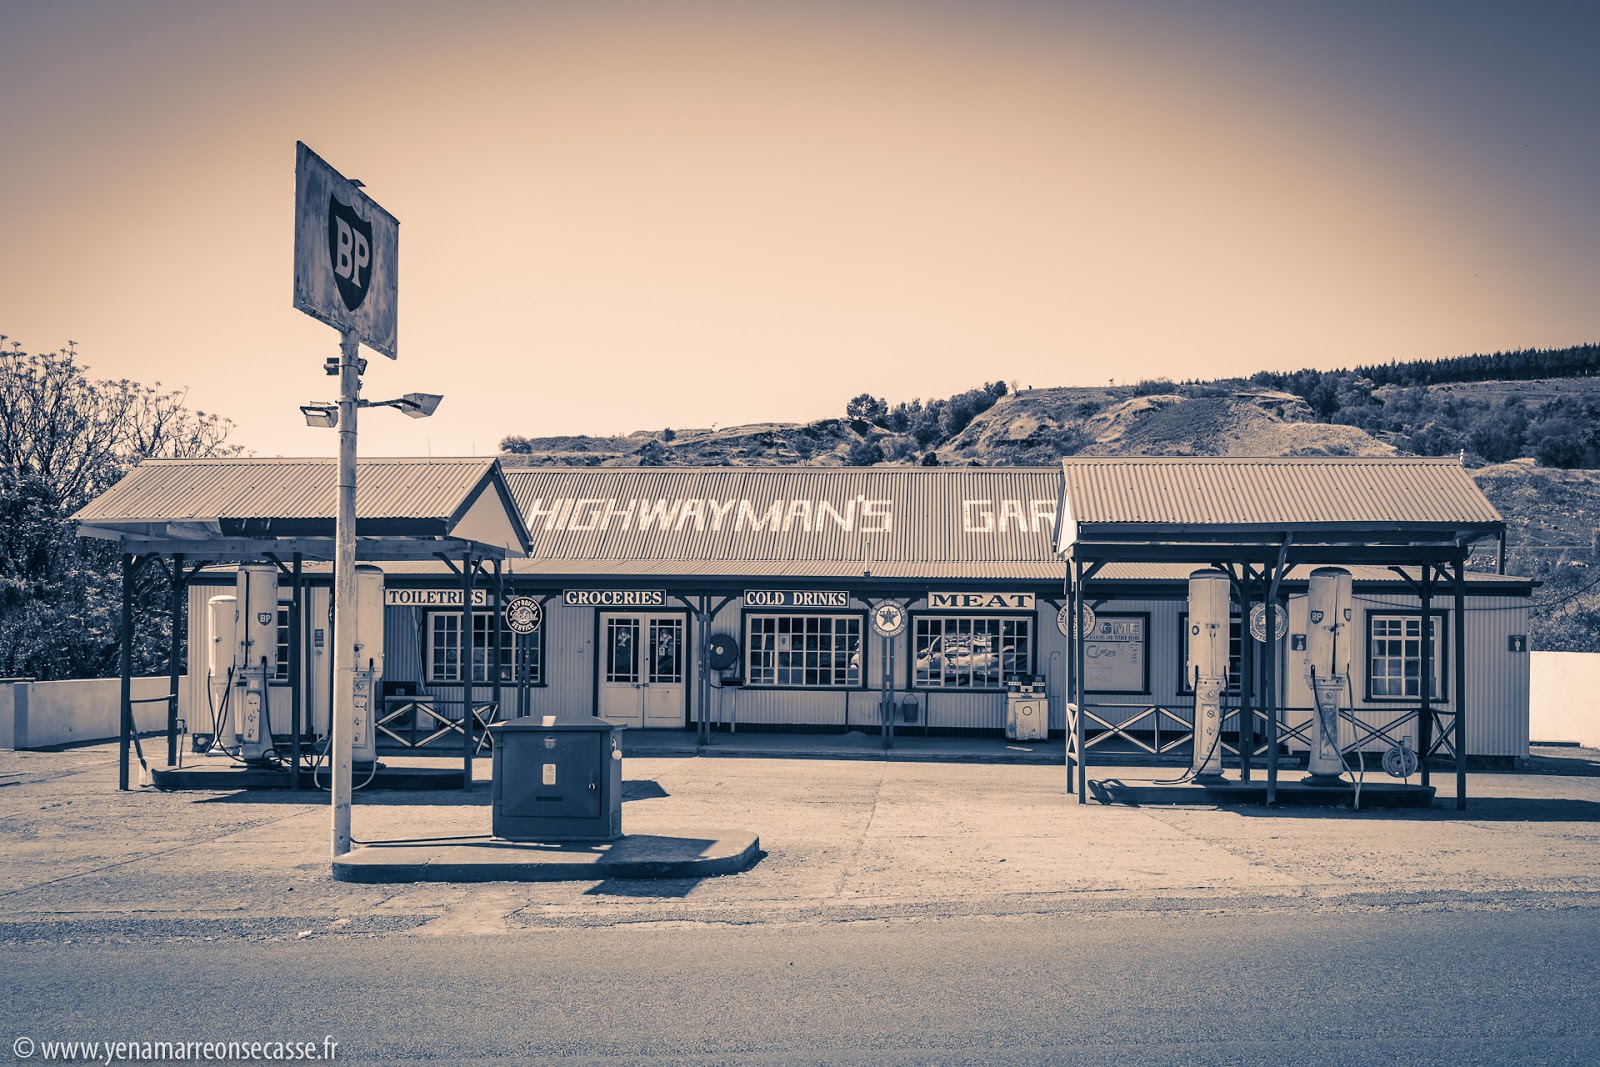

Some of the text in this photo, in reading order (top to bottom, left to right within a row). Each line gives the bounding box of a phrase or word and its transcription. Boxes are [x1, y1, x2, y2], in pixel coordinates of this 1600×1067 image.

[334, 215, 369, 288] BP
[526, 495, 892, 532] HIGHWAYMAN'S
[389, 590, 484, 604] TOILETRIS
[565, 591, 662, 604] GROCERIES
[746, 591, 847, 606] COLD DRINKS
[931, 594, 1033, 608] MEAT
[260, 614, 271, 623] BP
[511, 621, 535, 631] SERVICE
